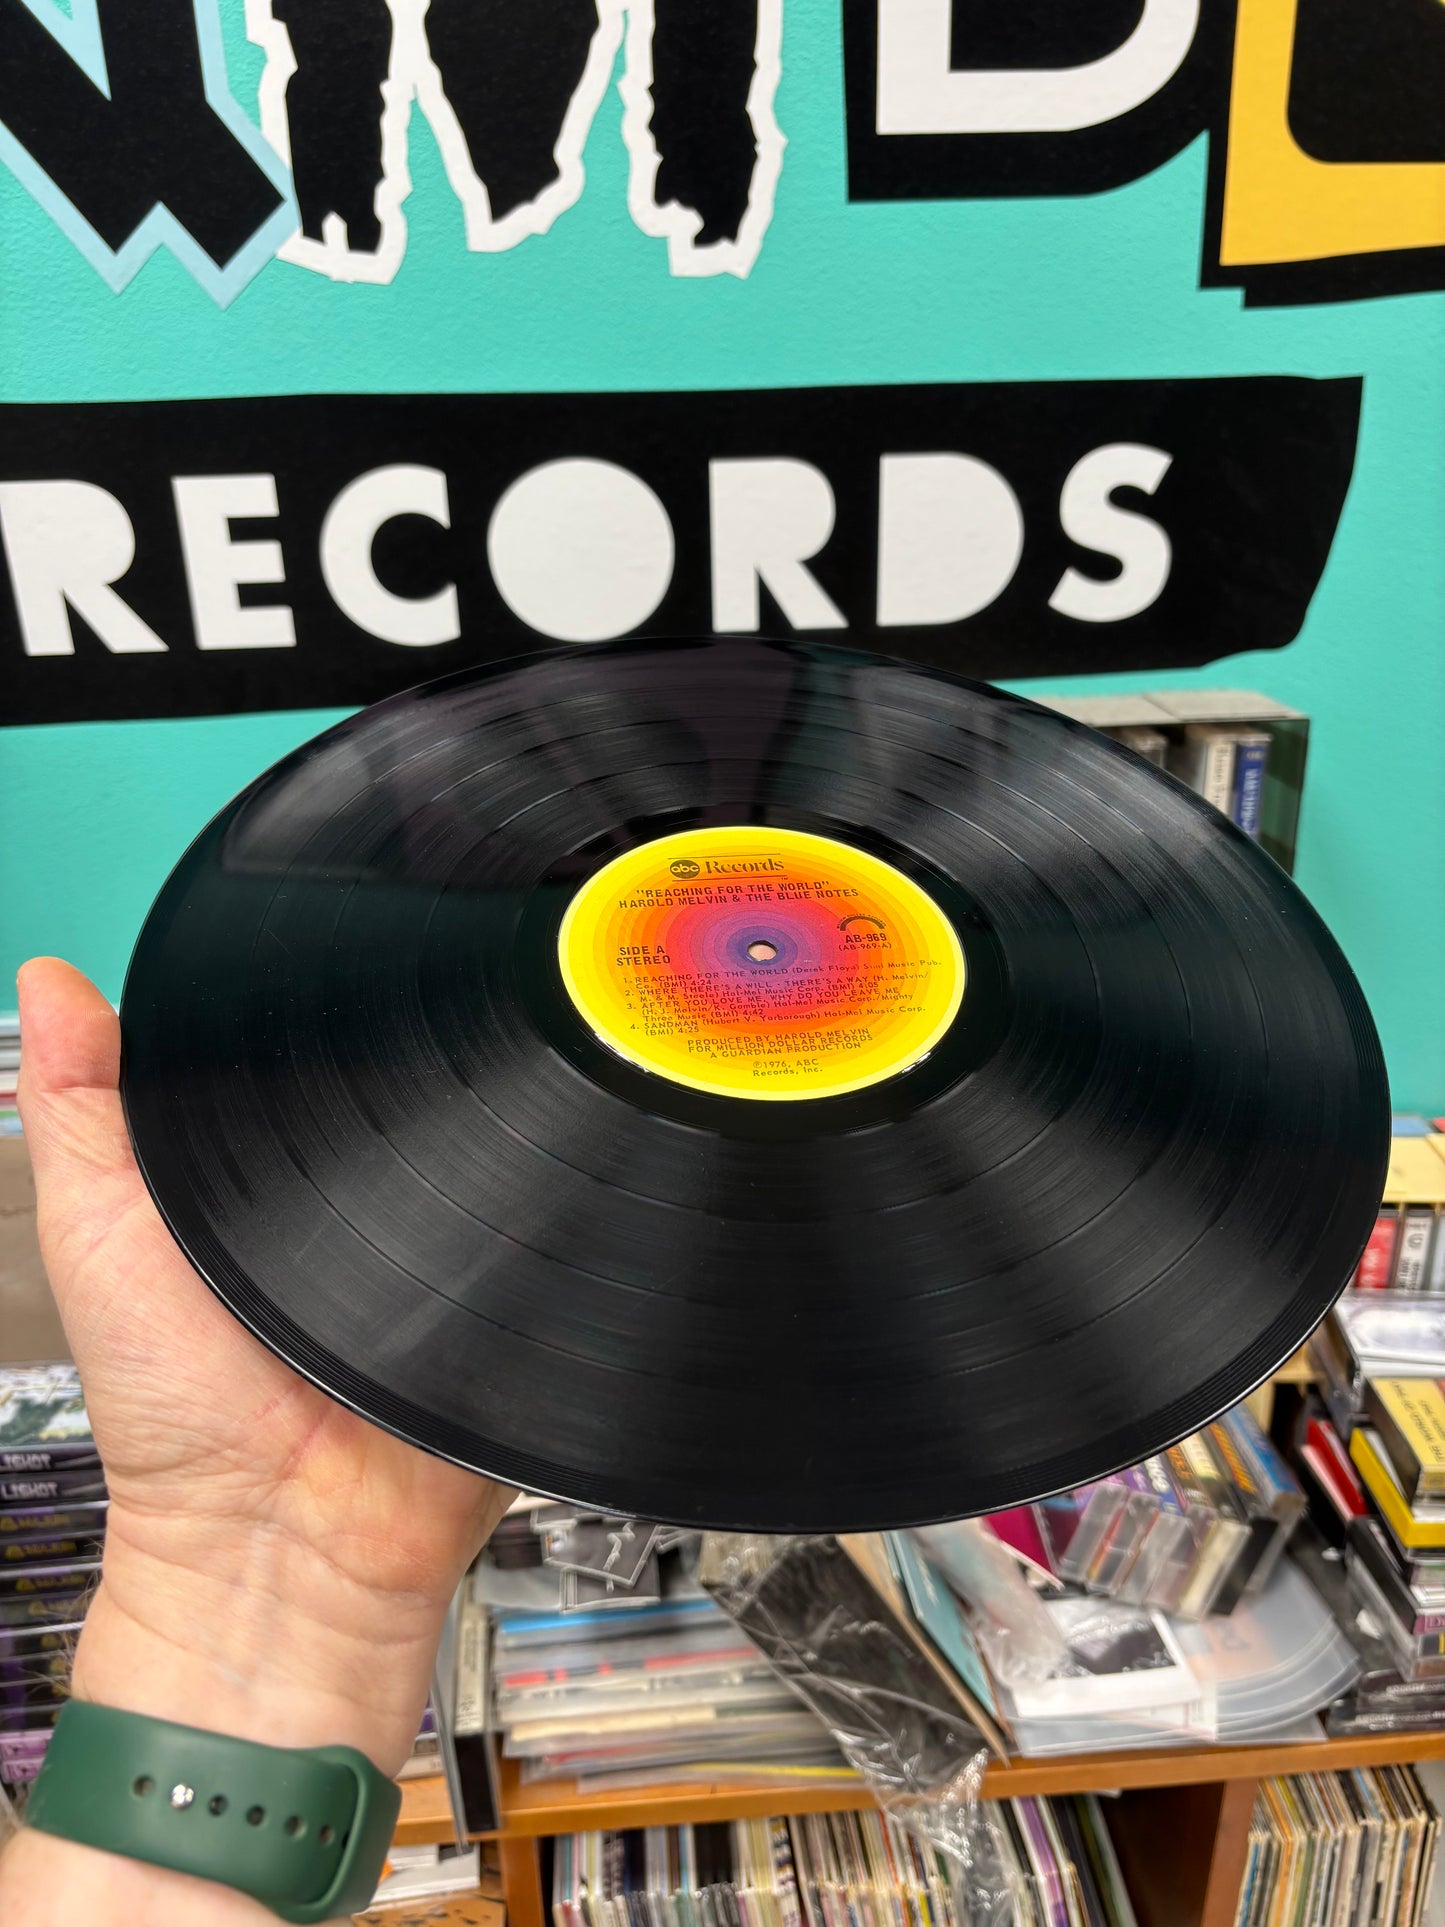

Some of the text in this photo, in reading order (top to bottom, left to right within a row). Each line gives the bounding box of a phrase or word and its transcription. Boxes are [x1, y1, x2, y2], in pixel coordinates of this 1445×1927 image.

[0, 442, 1174, 655] RECORDS
[706, 858, 784, 874] Records
[636, 880, 830, 898] "REACHING FOR THE WORLD"
[619, 888, 859, 908] HAROLD MELVIN & THE BLUE NOTES
[846, 932, 886, 943] AB-969
[620, 946, 665, 956] SIDE A
[838, 942, 892, 951] (AB-969-A)
[616, 955, 670, 966] STEREO
[636, 974, 692, 982] REACHING
[660, 980, 686, 988] (BMI)
[684, 984, 730, 992] THERE'S
[785, 978, 832, 986] THERE'S
[828, 983, 854, 991] (BMI)
[712, 996, 742, 1004] LOVE
[844, 988, 880, 996] LEAVE
[710, 1010, 738, 1018] (BMI)
[644, 1020, 698, 1029] SANDMAN
[688, 1028, 870, 1046] PRODUCED BY HAROLD MELVIN
[716, 1042, 764, 1052] MILLION
[769, 1038, 816, 1048] DOLLAR
[820, 1034, 873, 1044] RECORDS
[722, 1048, 782, 1058] GUARDIAN
[787, 1042, 862, 1053] PRODUCTION
[753, 1068, 799, 1077] Records,
